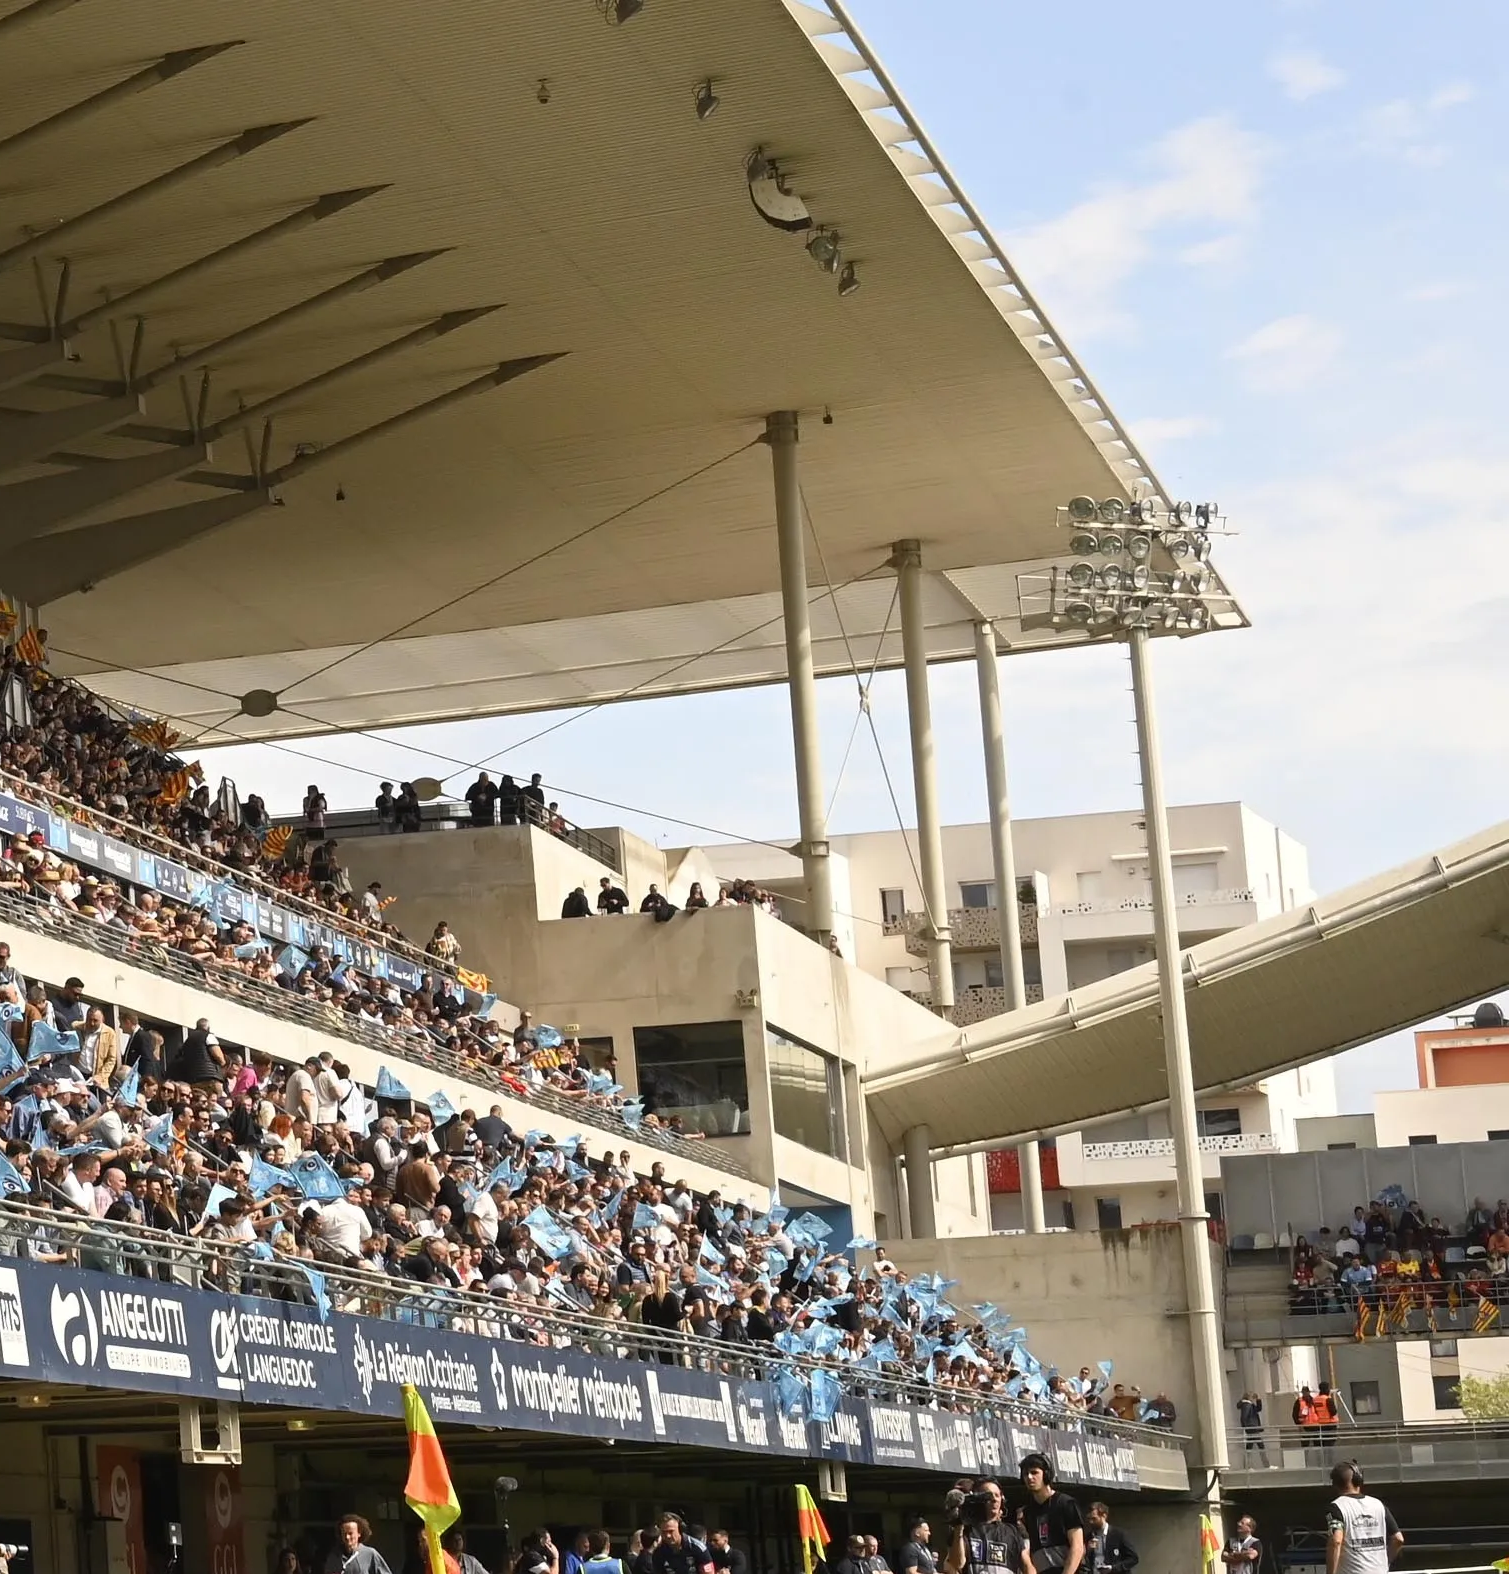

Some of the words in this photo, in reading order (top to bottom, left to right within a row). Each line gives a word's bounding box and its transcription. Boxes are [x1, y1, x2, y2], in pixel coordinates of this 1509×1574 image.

[100, 1290, 187, 1346] ANGELOTTI
[239, 1308, 281, 1347] CRÉDIT
[283, 1320, 338, 1354] AGRICOLE
[245, 1353, 317, 1389] LANGUEDOC
[371, 1340, 388, 1381] La
[385, 1342, 429, 1388] Région
[426, 1349, 478, 1393] Occitanie
